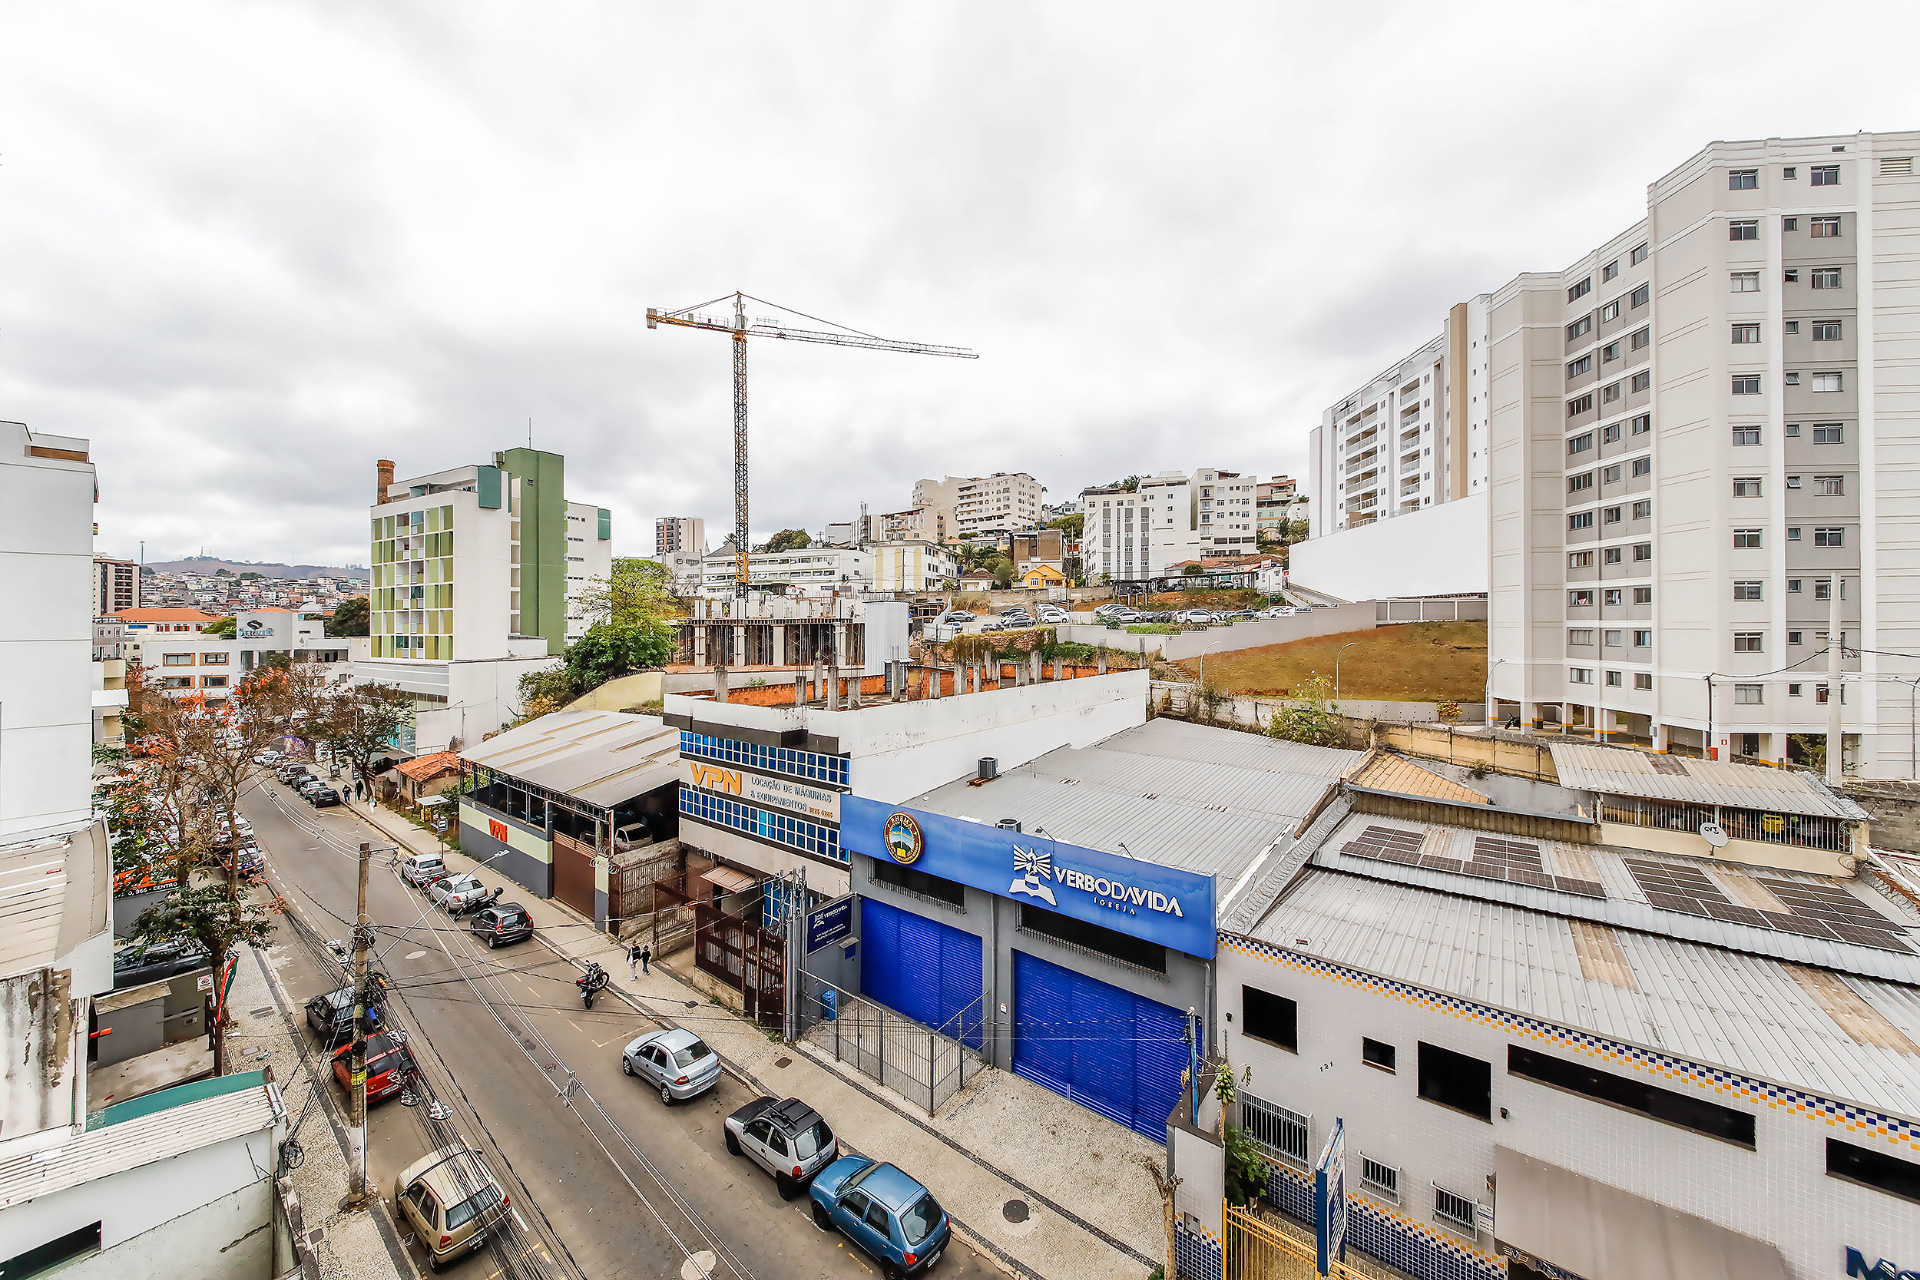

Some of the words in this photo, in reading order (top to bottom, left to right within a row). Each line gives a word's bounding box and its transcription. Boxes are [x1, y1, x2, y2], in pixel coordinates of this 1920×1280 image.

[690, 762, 742, 796] VPN
[751, 776, 780, 791] LOCAÇÃO
[783, 784, 793, 794] DE
[794, 786, 832, 804] MÁQUINAS
[756, 791, 808, 812] EQUIPAMENTOS
[488, 818, 508, 843] VPN
[152, 881, 178, 890] CENTRO
[1053, 865, 1184, 918] VERBODAVIDA
[1093, 896, 1137, 916] IGREJA
[1319, 1060, 1333, 1073] 121
